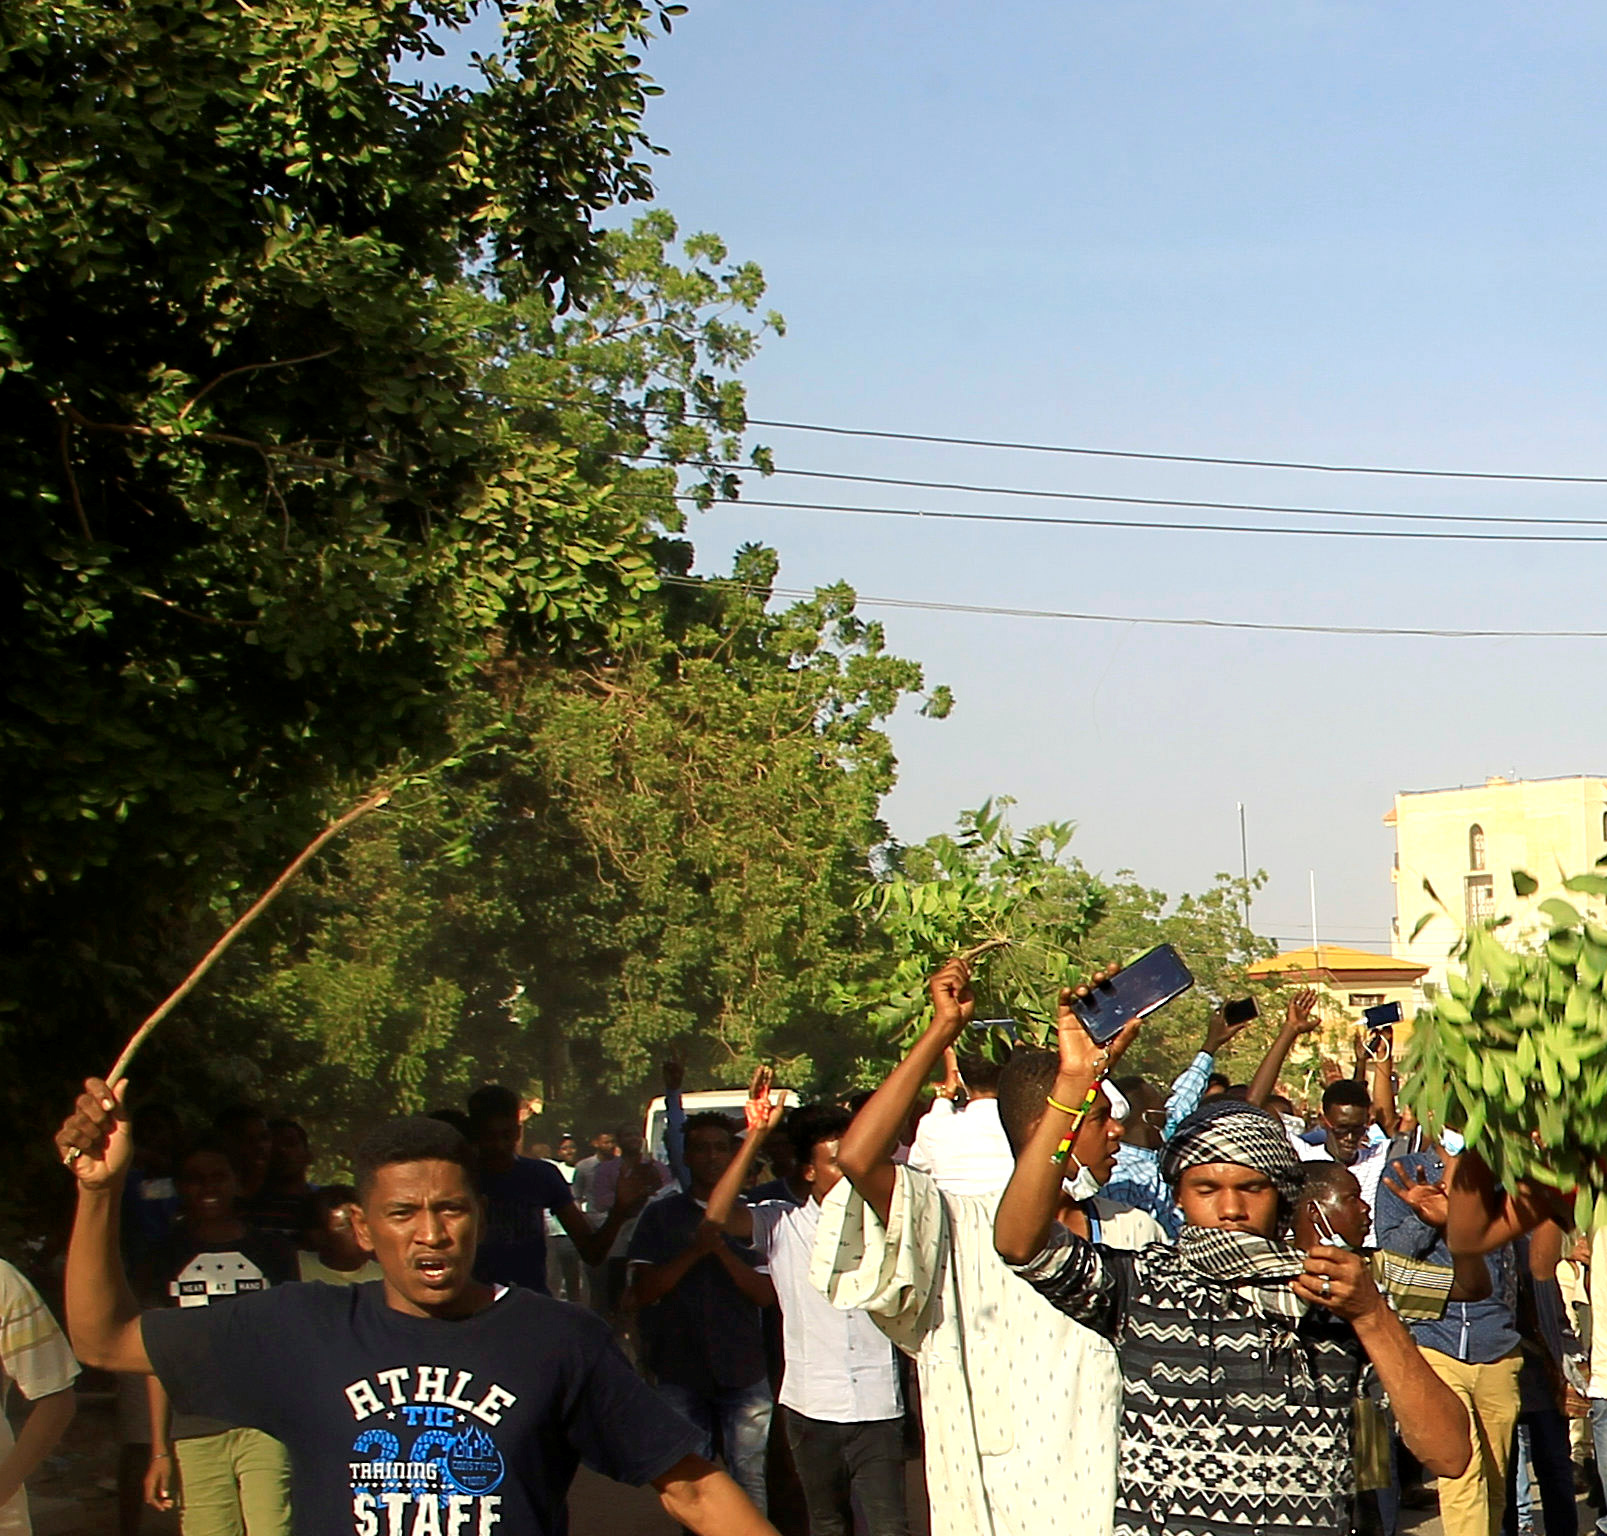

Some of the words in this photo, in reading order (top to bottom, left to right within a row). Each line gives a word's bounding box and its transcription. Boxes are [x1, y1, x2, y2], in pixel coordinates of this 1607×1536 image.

[215, 1283, 227, 1291] AT
[344, 1365, 518, 1427] ATHLE
[402, 1405, 455, 1428] TIC
[349, 1462, 438, 1481] TRAINING
